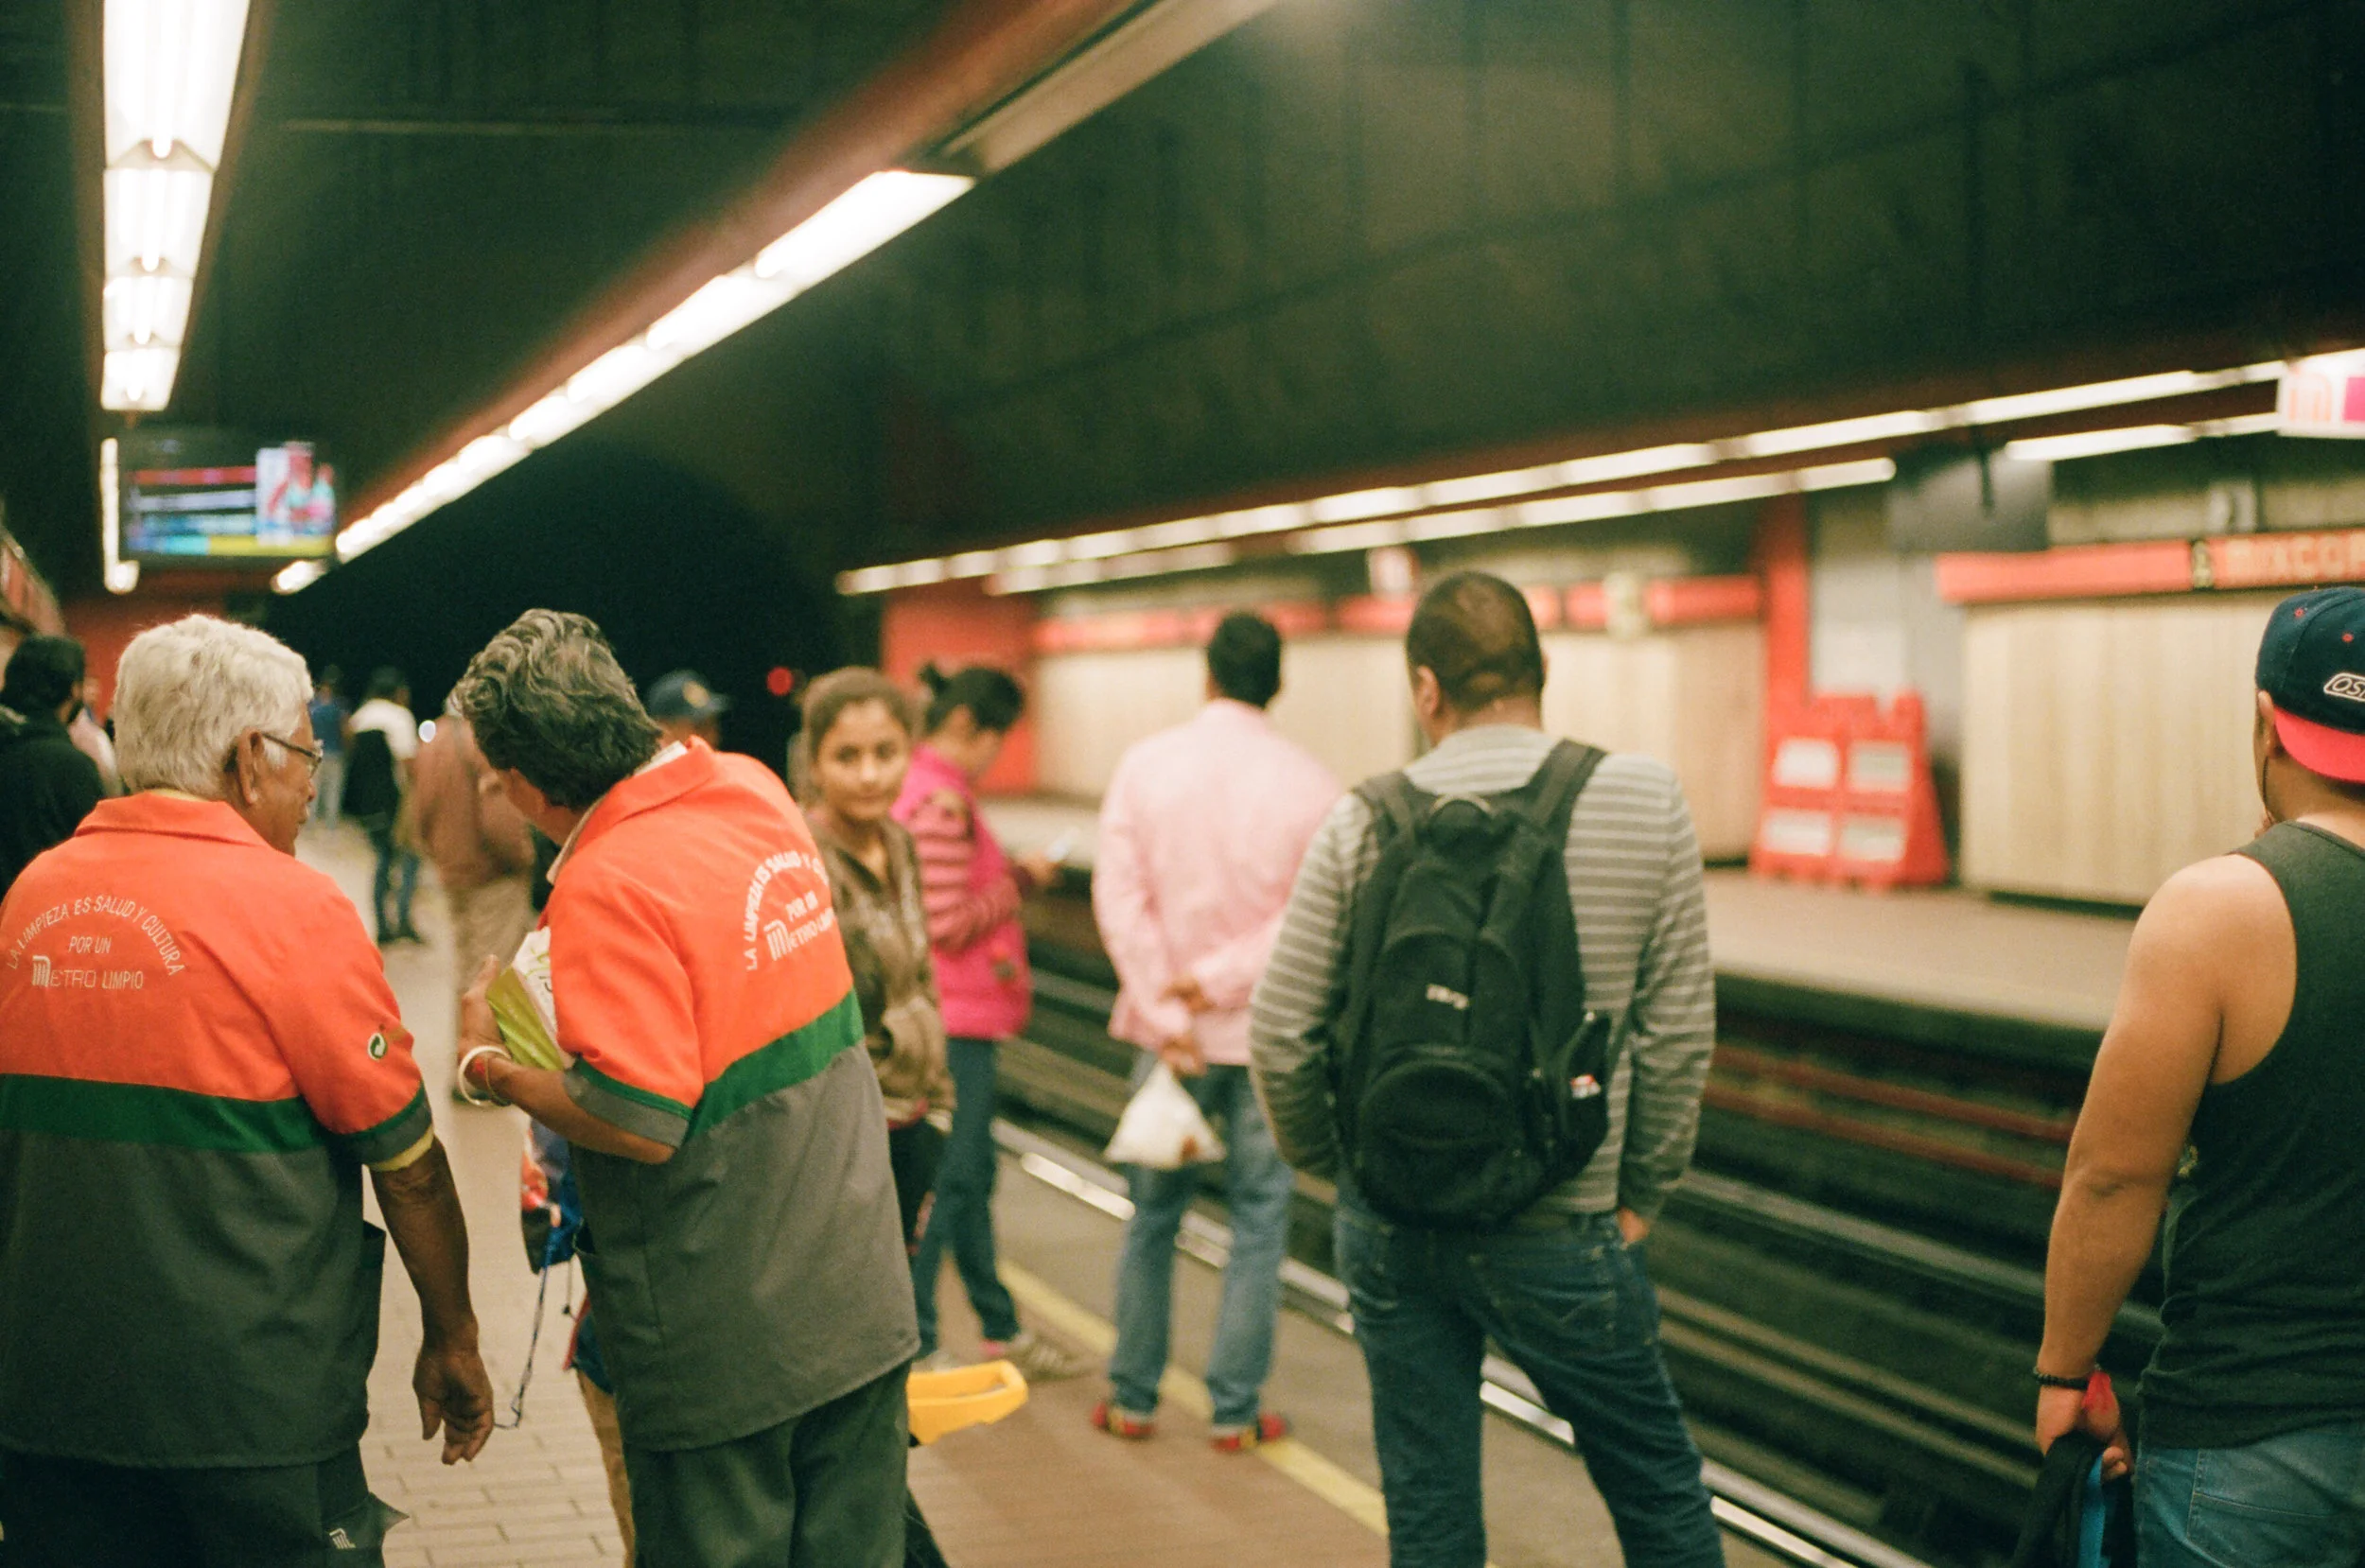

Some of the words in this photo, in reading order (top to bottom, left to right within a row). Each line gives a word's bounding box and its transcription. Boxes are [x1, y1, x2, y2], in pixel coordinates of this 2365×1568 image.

[2332, 677, 2365, 698] OS
[7, 949, 22, 970] LA
[16, 903, 70, 950] LIMPIEZA
[74, 896, 92, 916] ES
[93, 895, 136, 917] SALUD
[132, 906, 149, 923] Y
[141, 915, 185, 977] CULTURA
[68, 935, 93, 954] POR
[95, 936, 112, 954] UN
[31, 954, 96, 989] METRO
[101, 970, 144, 990] LIMPIO
